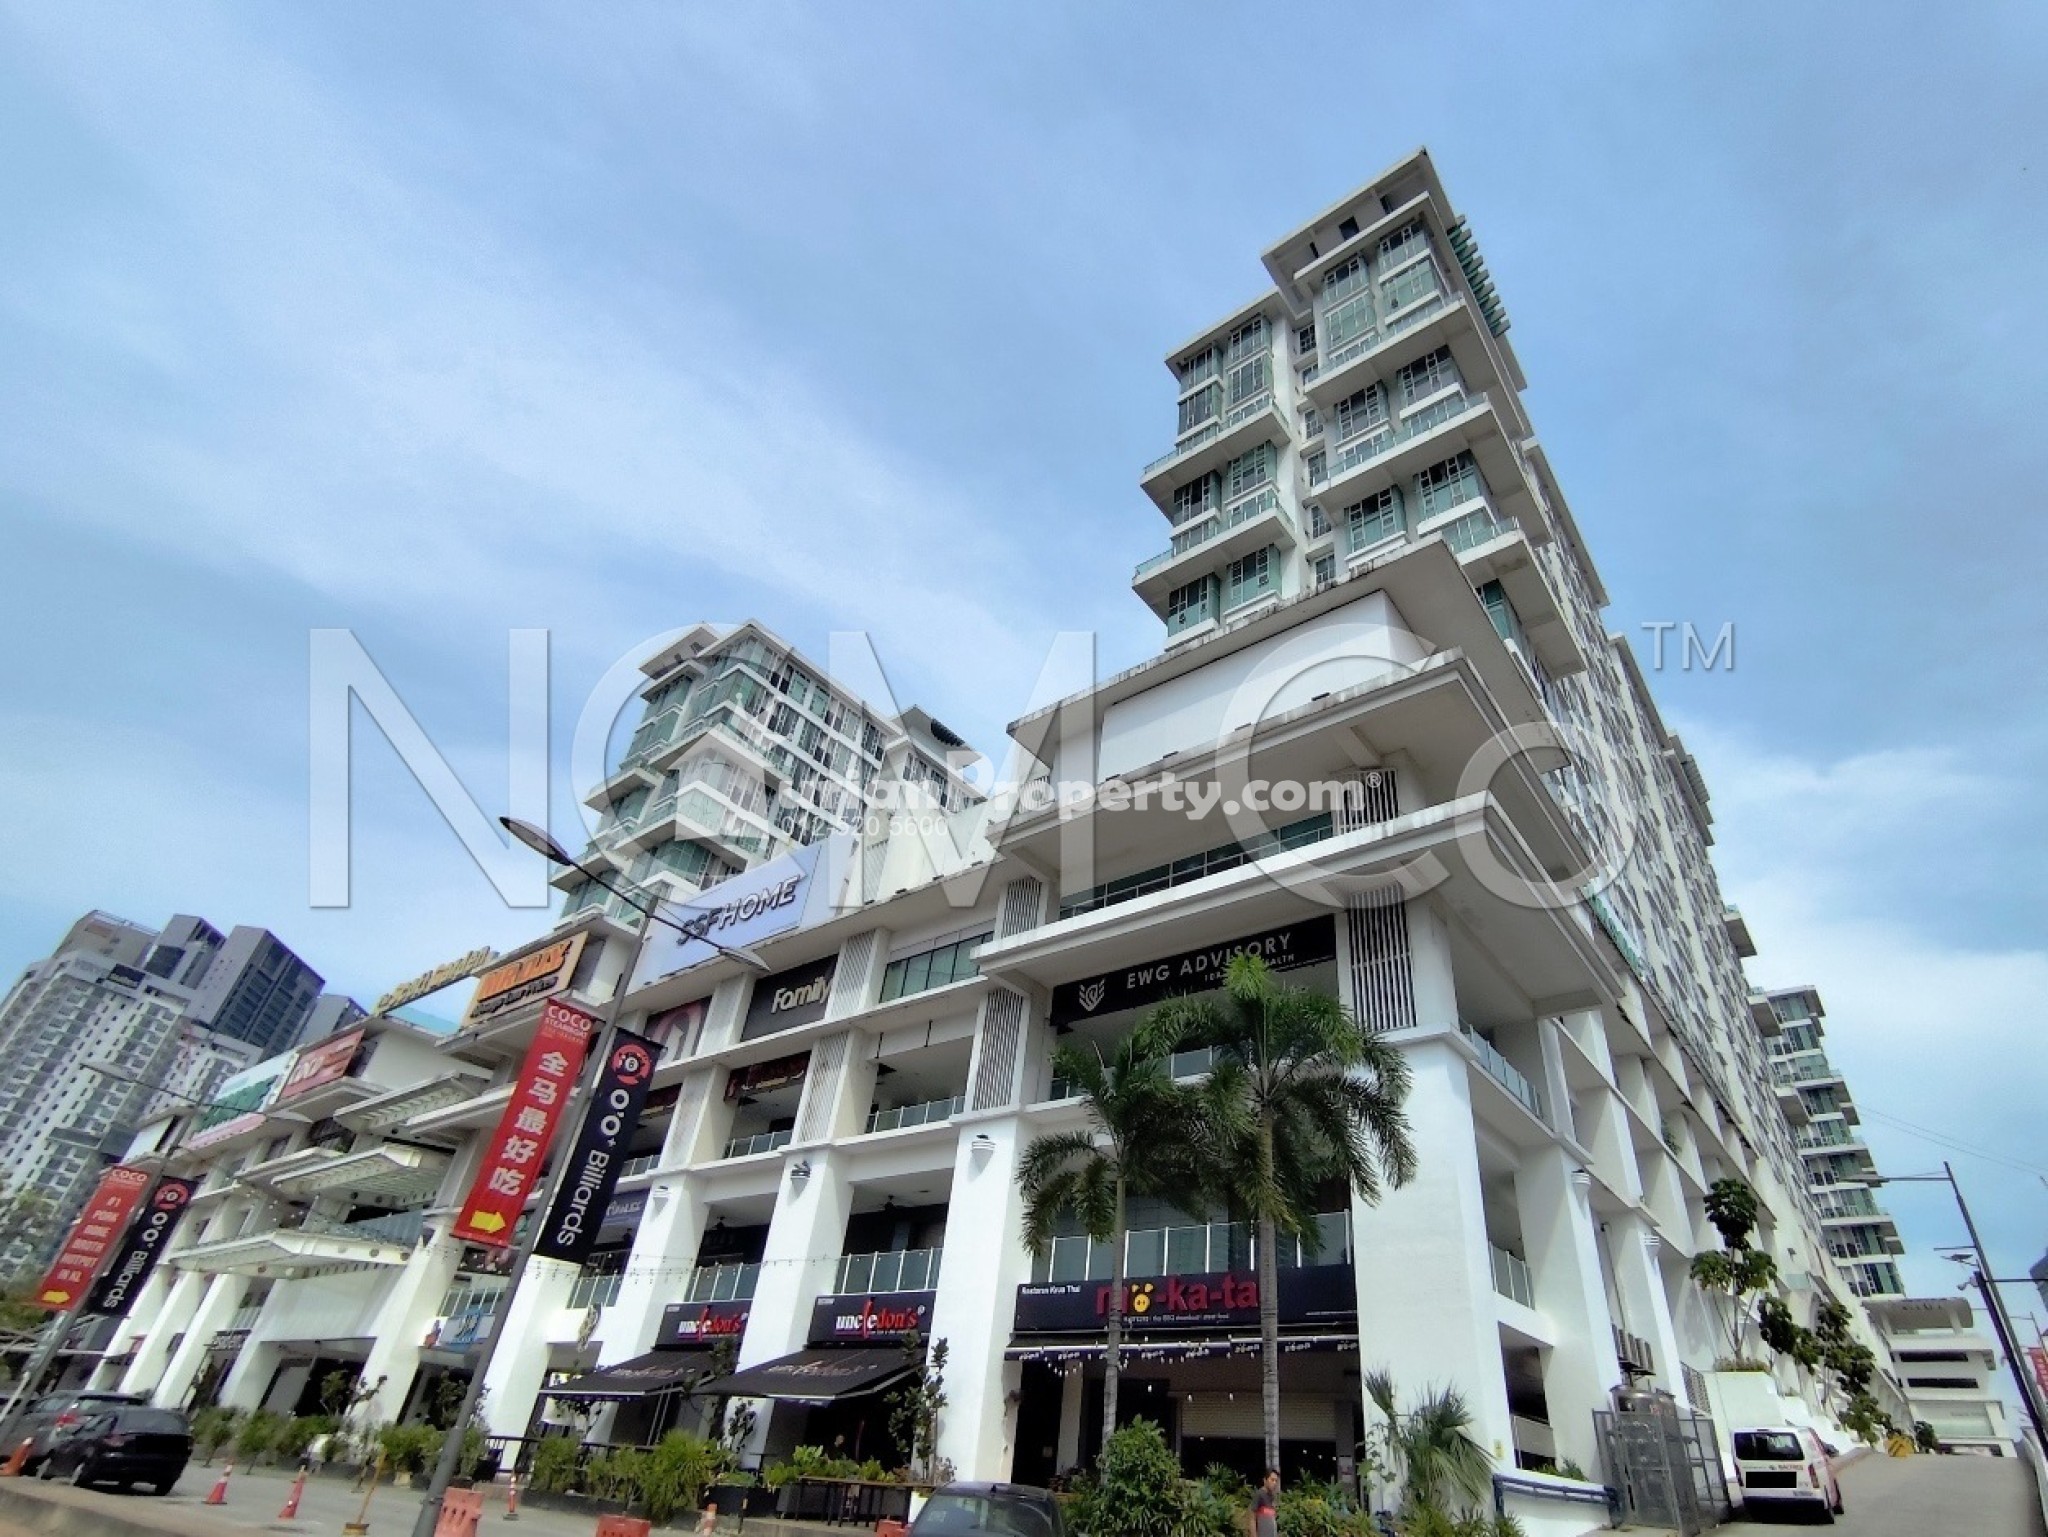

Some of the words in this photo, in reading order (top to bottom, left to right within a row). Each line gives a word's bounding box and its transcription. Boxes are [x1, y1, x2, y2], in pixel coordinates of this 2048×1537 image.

[1126, 964, 1170, 989] EWG
[1180, 931, 1291, 976] ADVISORY
[549, 1005, 592, 1032] COCO
[488, 1051, 568, 1197] 全马最好吃
[112, 1169, 148, 1182] COCO
[556, 1149, 610, 1247] Billiards
[103, 1250, 148, 1308] Billiards
